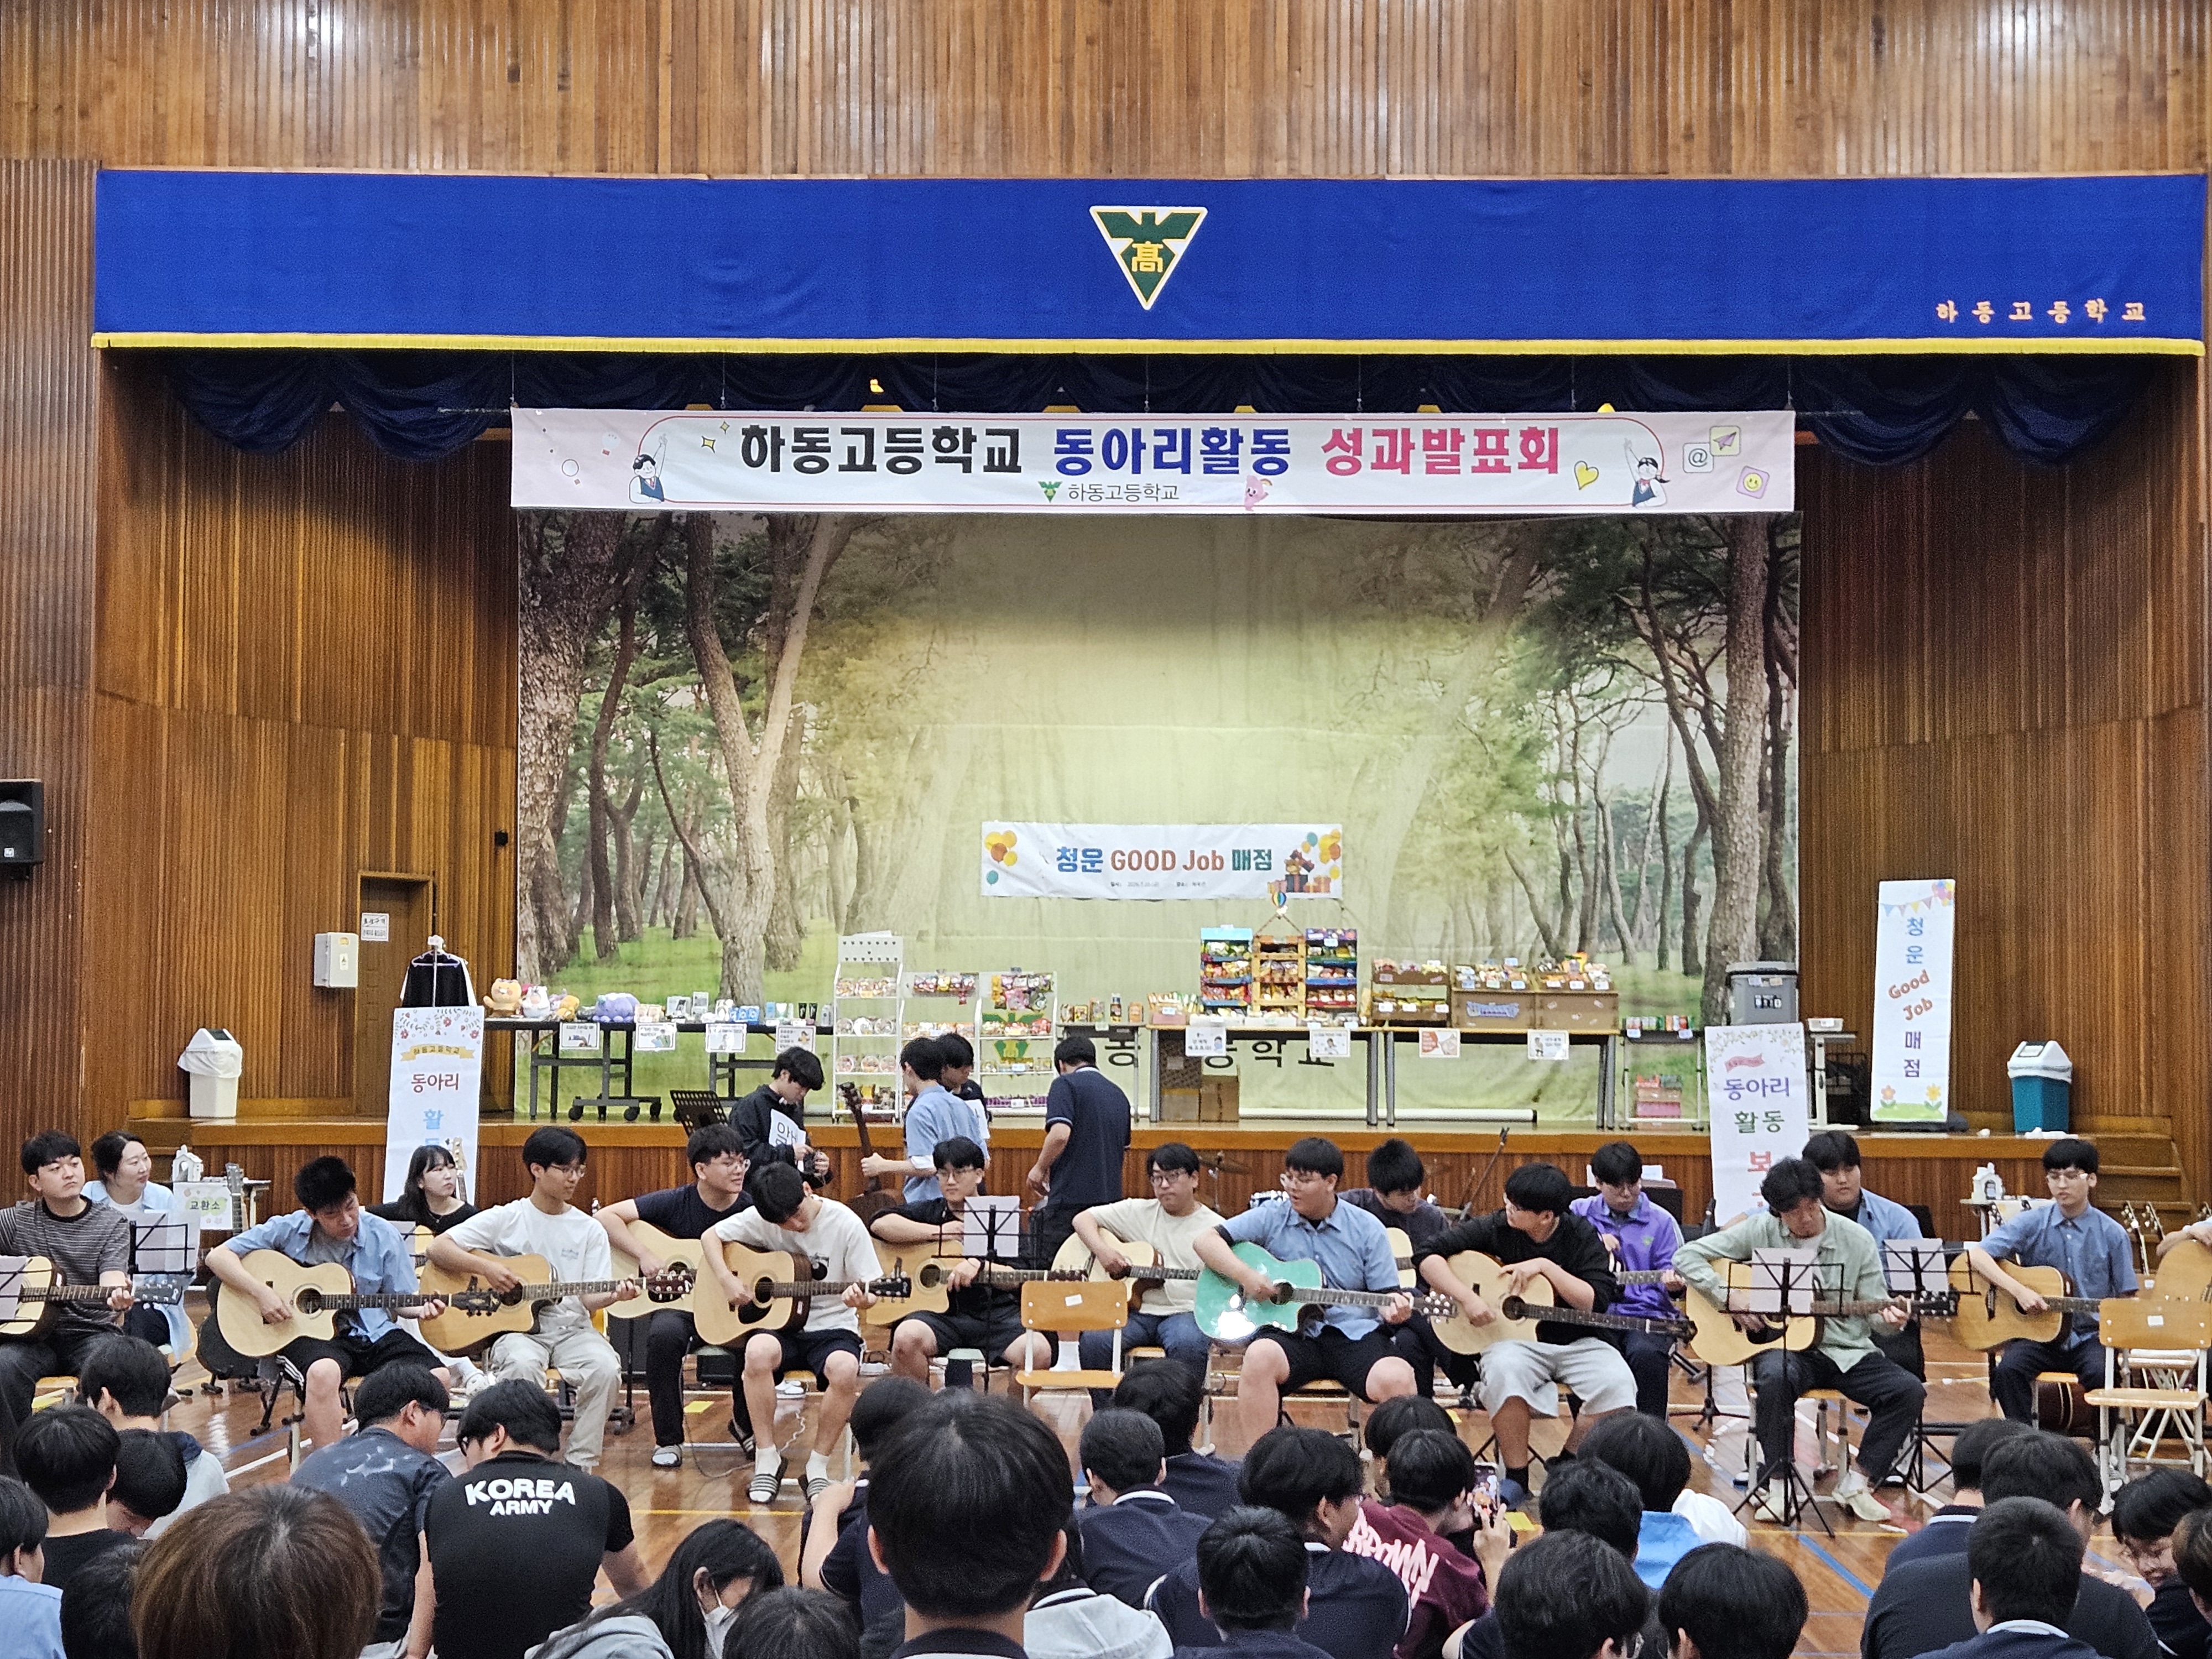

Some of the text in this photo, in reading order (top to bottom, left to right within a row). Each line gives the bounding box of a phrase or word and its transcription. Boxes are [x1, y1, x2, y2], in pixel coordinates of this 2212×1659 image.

[1936, 298, 2146, 324] 하동고등학교
[741, 424, 1559, 477] 하동고등학교 동아리활동 성과발표회
[1068, 482, 1180, 503] 하동고등학교
[1056, 847, 1272, 873] 청운 GOOD Job 매점
[1888, 969, 1931, 1000] Good
[1903, 997, 1933, 1021] Job
[411, 1073, 460, 1093] 동아리
[1723, 1077, 1790, 1101] 동아리
[1734, 1110, 1785, 1134] 활동
[190, 1199, 221, 1211] 교환소
[465, 1478, 576, 1506] KOREA
[489, 1500, 554, 1516] ARMY
